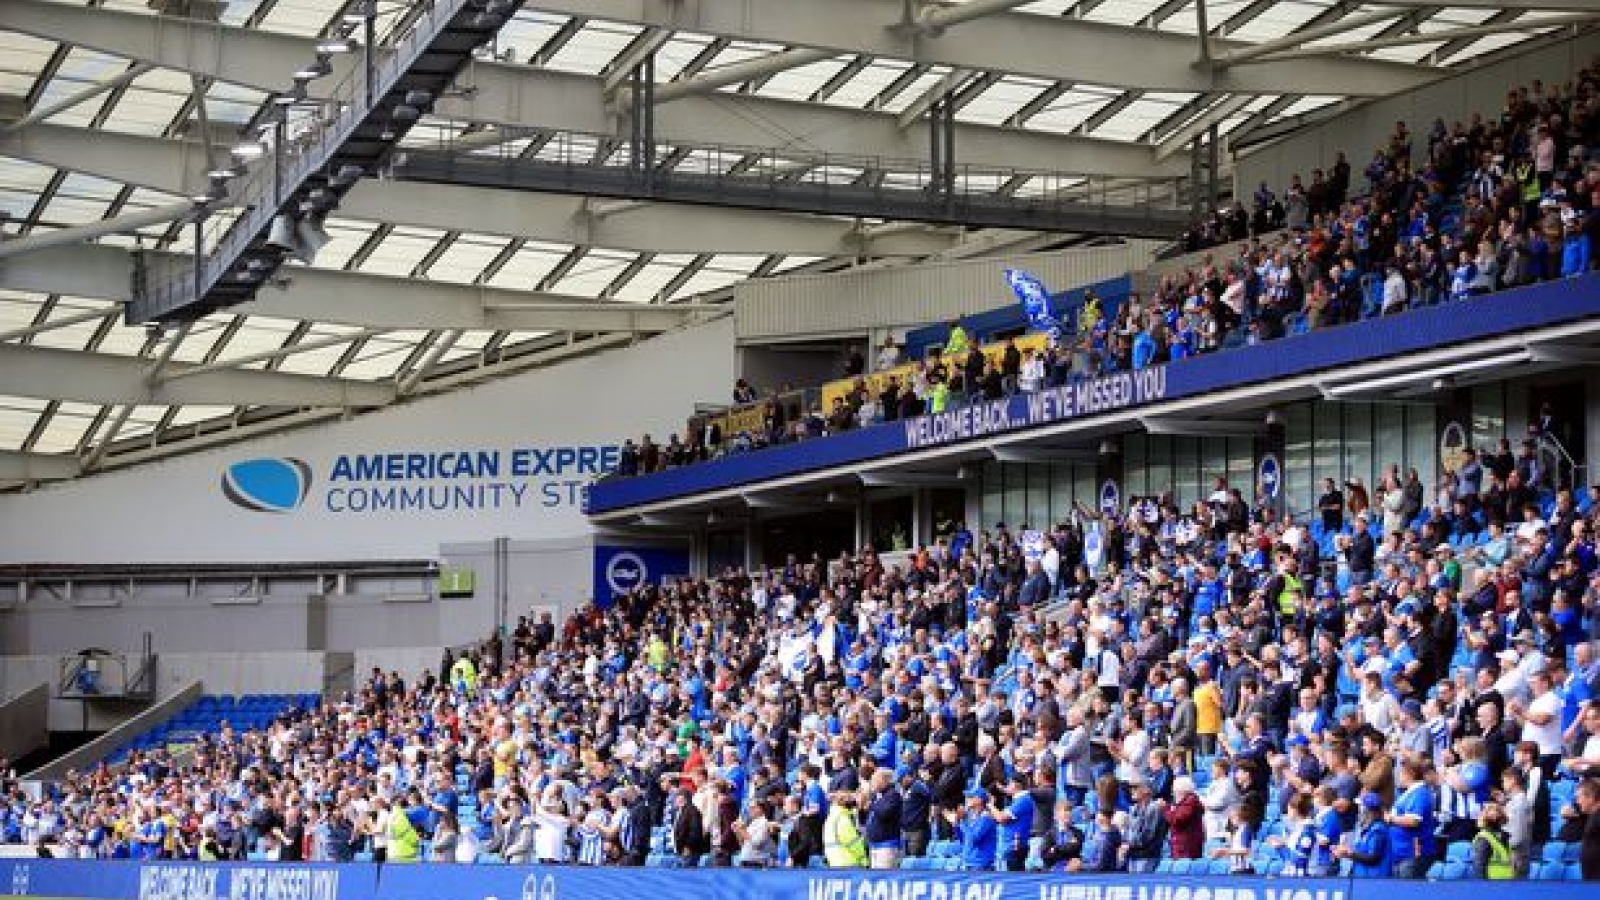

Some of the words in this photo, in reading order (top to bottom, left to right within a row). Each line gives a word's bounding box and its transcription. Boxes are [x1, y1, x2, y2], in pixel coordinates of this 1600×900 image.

[904, 408, 971, 448] WELCOME
[1076, 373, 1132, 415] MISSED
[1133, 364, 1167, 402] YOU
[329, 450, 499, 481] AMERICAN
[511, 445, 619, 476] EXPRE
[327, 482, 527, 513] COMMUNITY
[541, 480, 582, 508] ST
